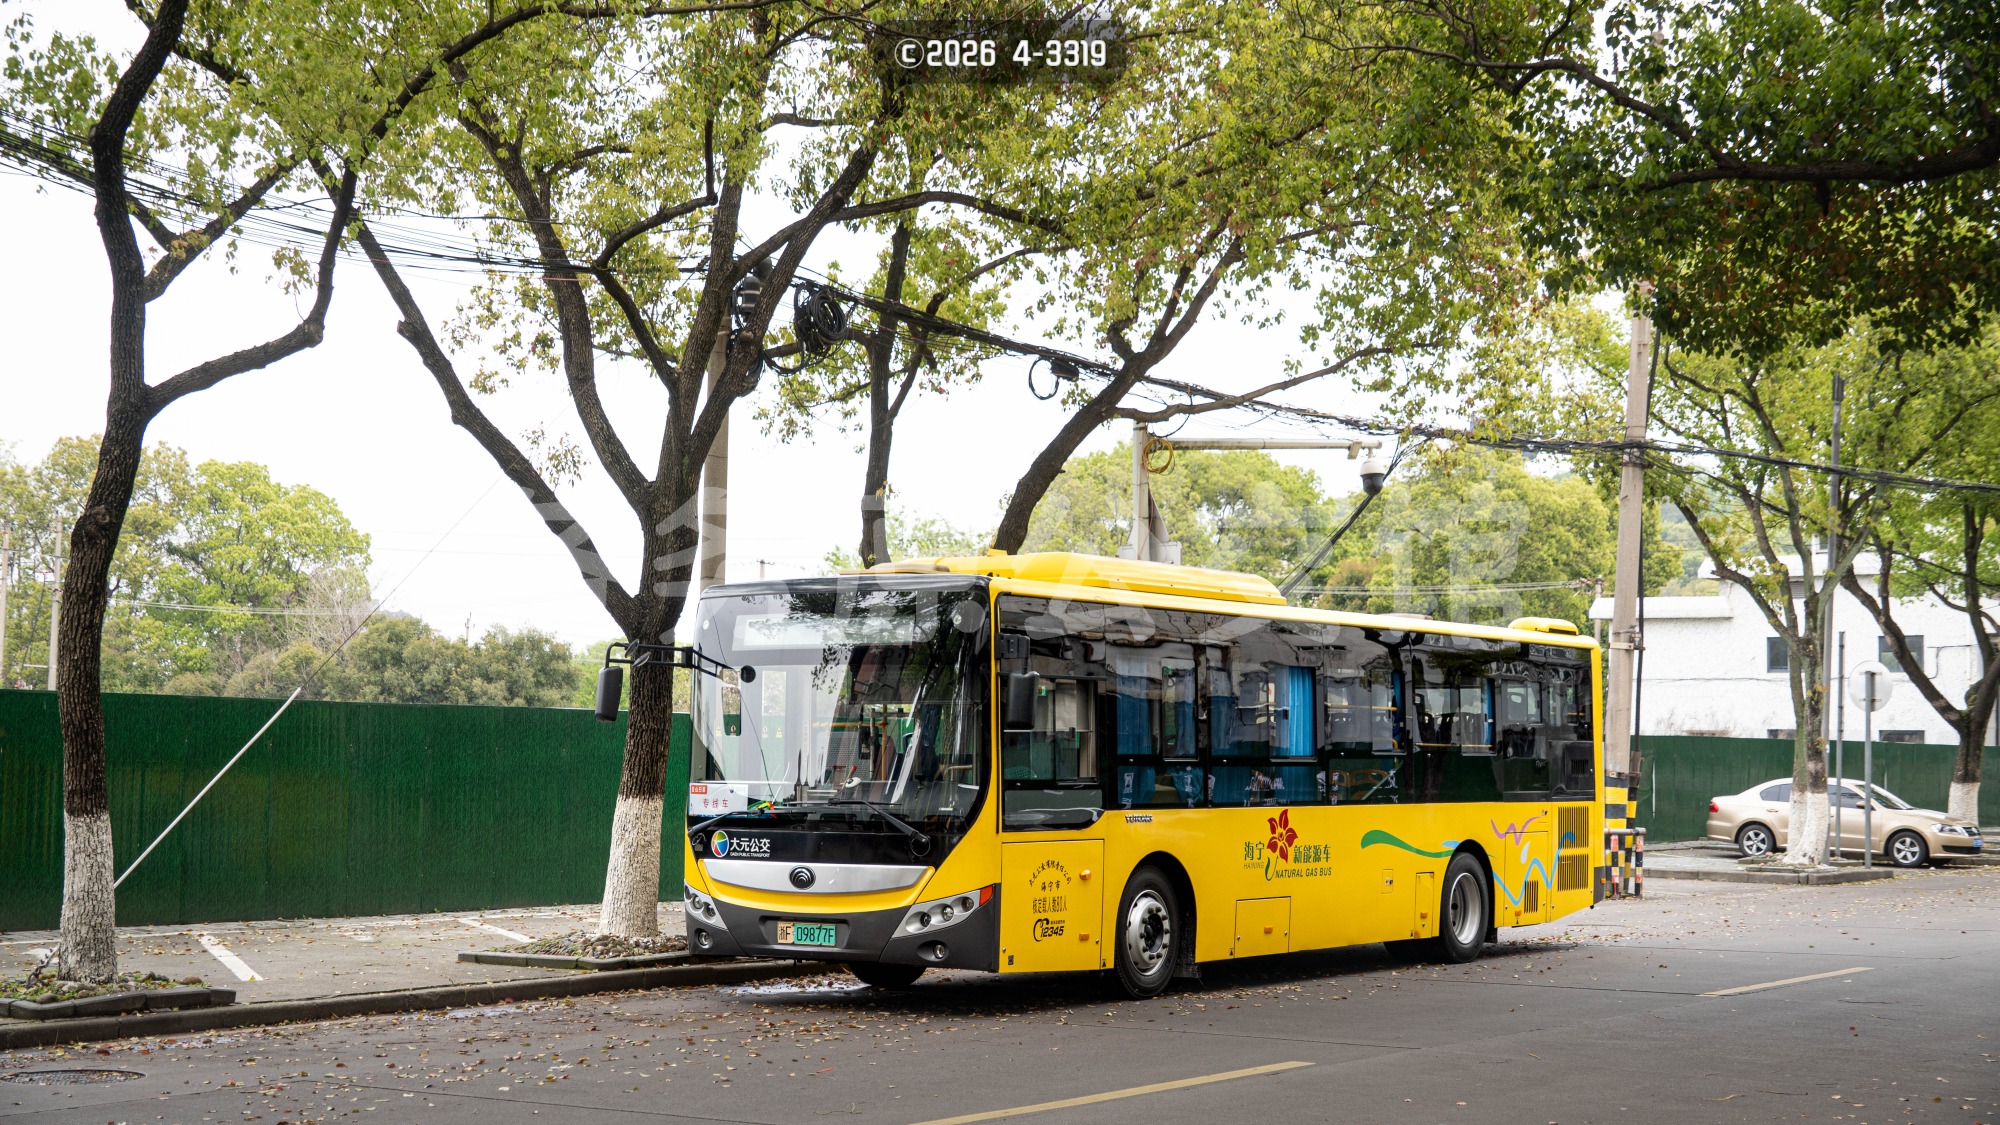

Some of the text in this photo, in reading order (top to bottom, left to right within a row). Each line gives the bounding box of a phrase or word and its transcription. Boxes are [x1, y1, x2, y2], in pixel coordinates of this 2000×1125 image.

[703, 798, 728, 809] 专线车
[730, 837, 771, 853] 大元公交
[1244, 840, 1265, 861] 海宁
[1293, 843, 1332, 864] 新能源车
[1243, 861, 1265, 870] HAINING
[1275, 866, 1332, 879] NATURAL GAS BUS
[1041, 879, 1061, 892] 海宁市
[1040, 925, 1065, 938] 12345
